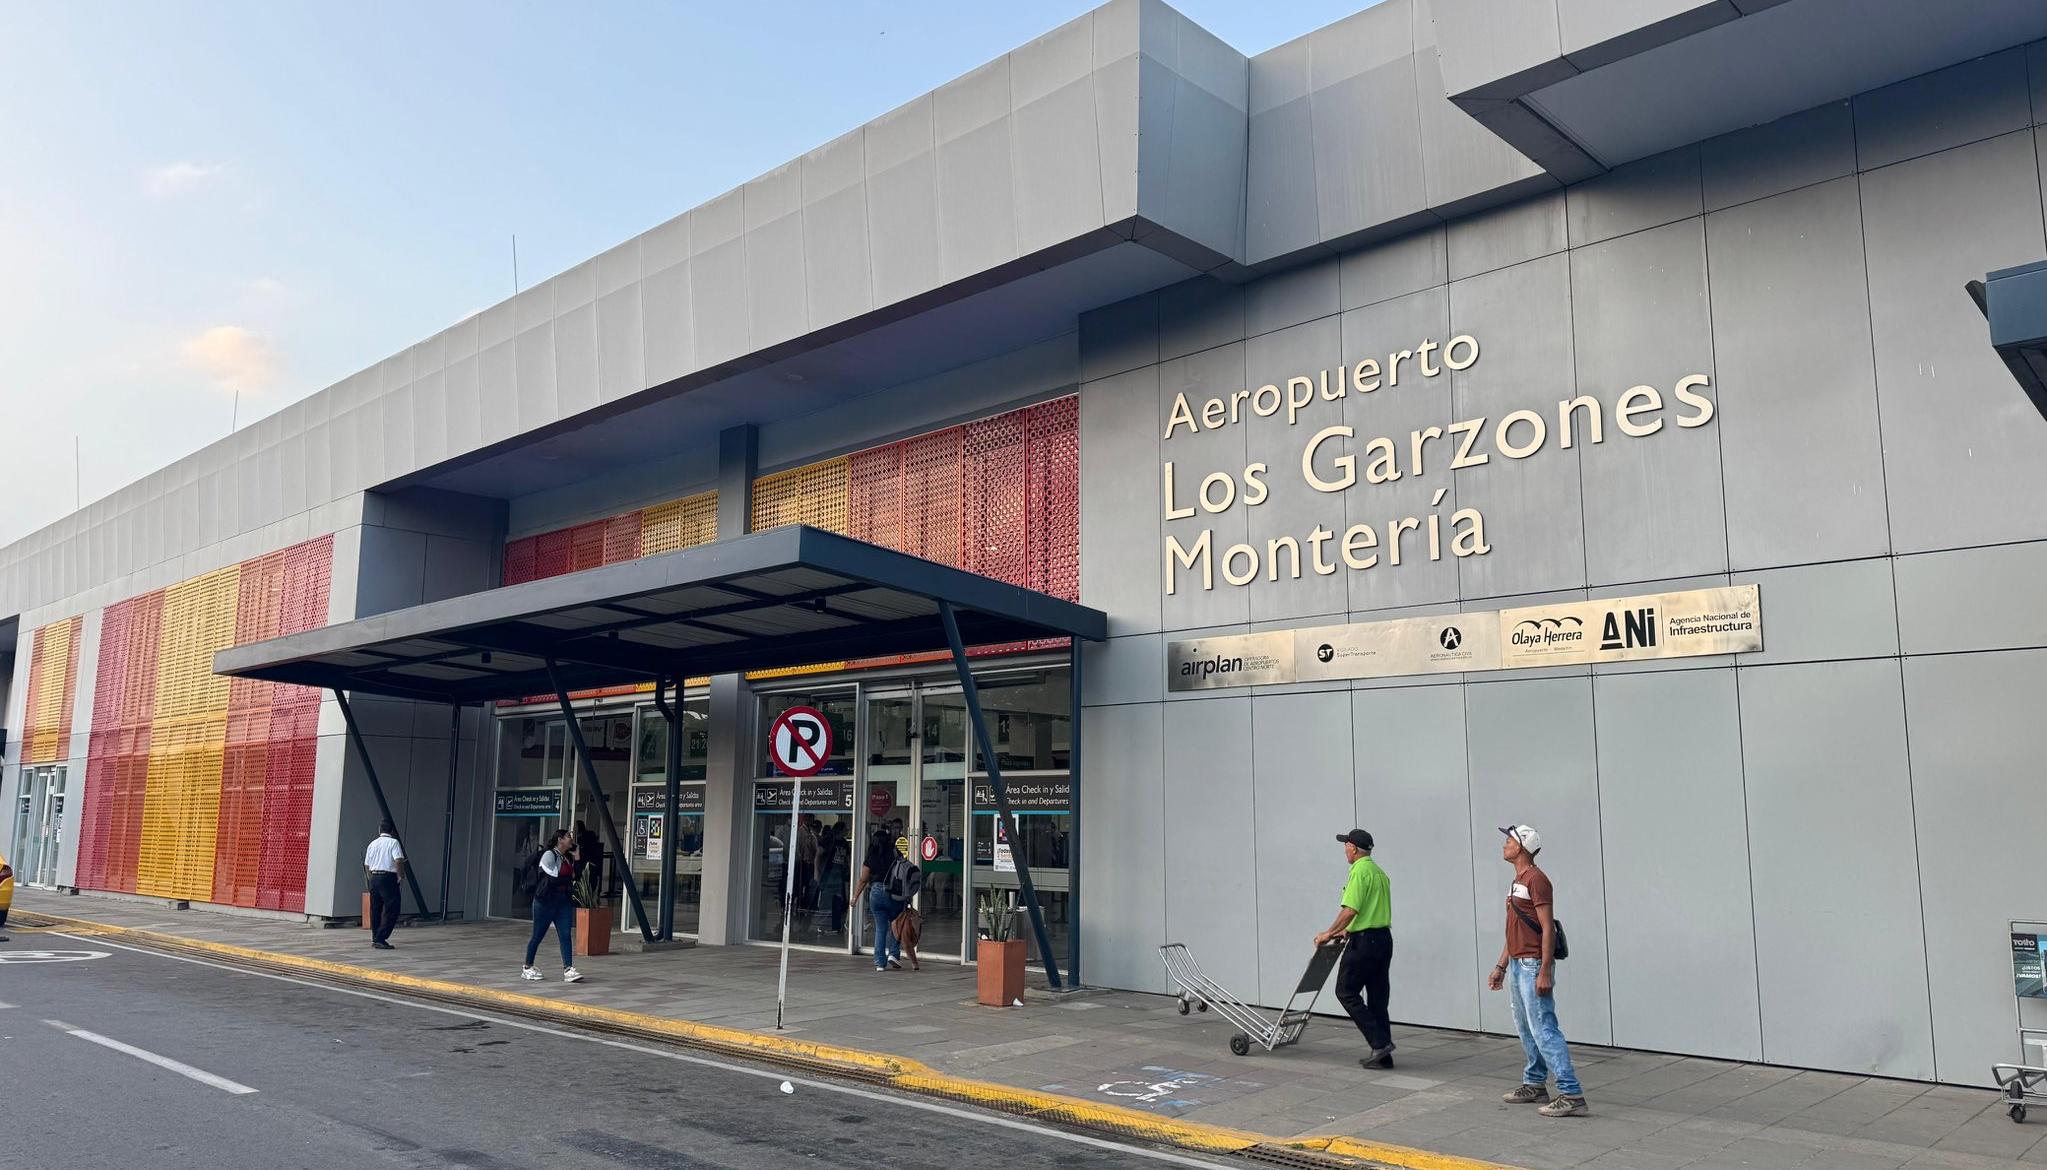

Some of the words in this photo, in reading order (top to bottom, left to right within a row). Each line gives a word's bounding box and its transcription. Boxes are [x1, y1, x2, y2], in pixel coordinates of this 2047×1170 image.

[1164, 334, 1480, 440] Aeropuerto
[1165, 461, 1269, 521] Los
[1301, 373, 1716, 494] Garzones
[1166, 488, 1491, 596] Montería
[1669, 616, 1701, 626] Agencia
[1703, 611, 1739, 622] Nacional
[1740, 611, 1752, 619] de
[1669, 621, 1753, 637] Infraestructura
[1511, 629, 1542, 648] Olaya
[1544, 627, 1583, 646] Herrera
[1318, 648, 1333, 659] ST
[1181, 648, 1243, 680] airplan
[789, 719, 820, 763] P
[791, 787, 807, 796] Ceck
[817, 787, 833, 796] Salidas
[1005, 783, 1020, 794] Área
[1021, 784, 1042, 794] Check
[1043, 785, 1049, 794] in
[1055, 784, 1070, 794] Salid
[555, 800, 560, 810] 4
[845, 794, 852, 807] 5
[1039, 797, 1069, 806] Departures
